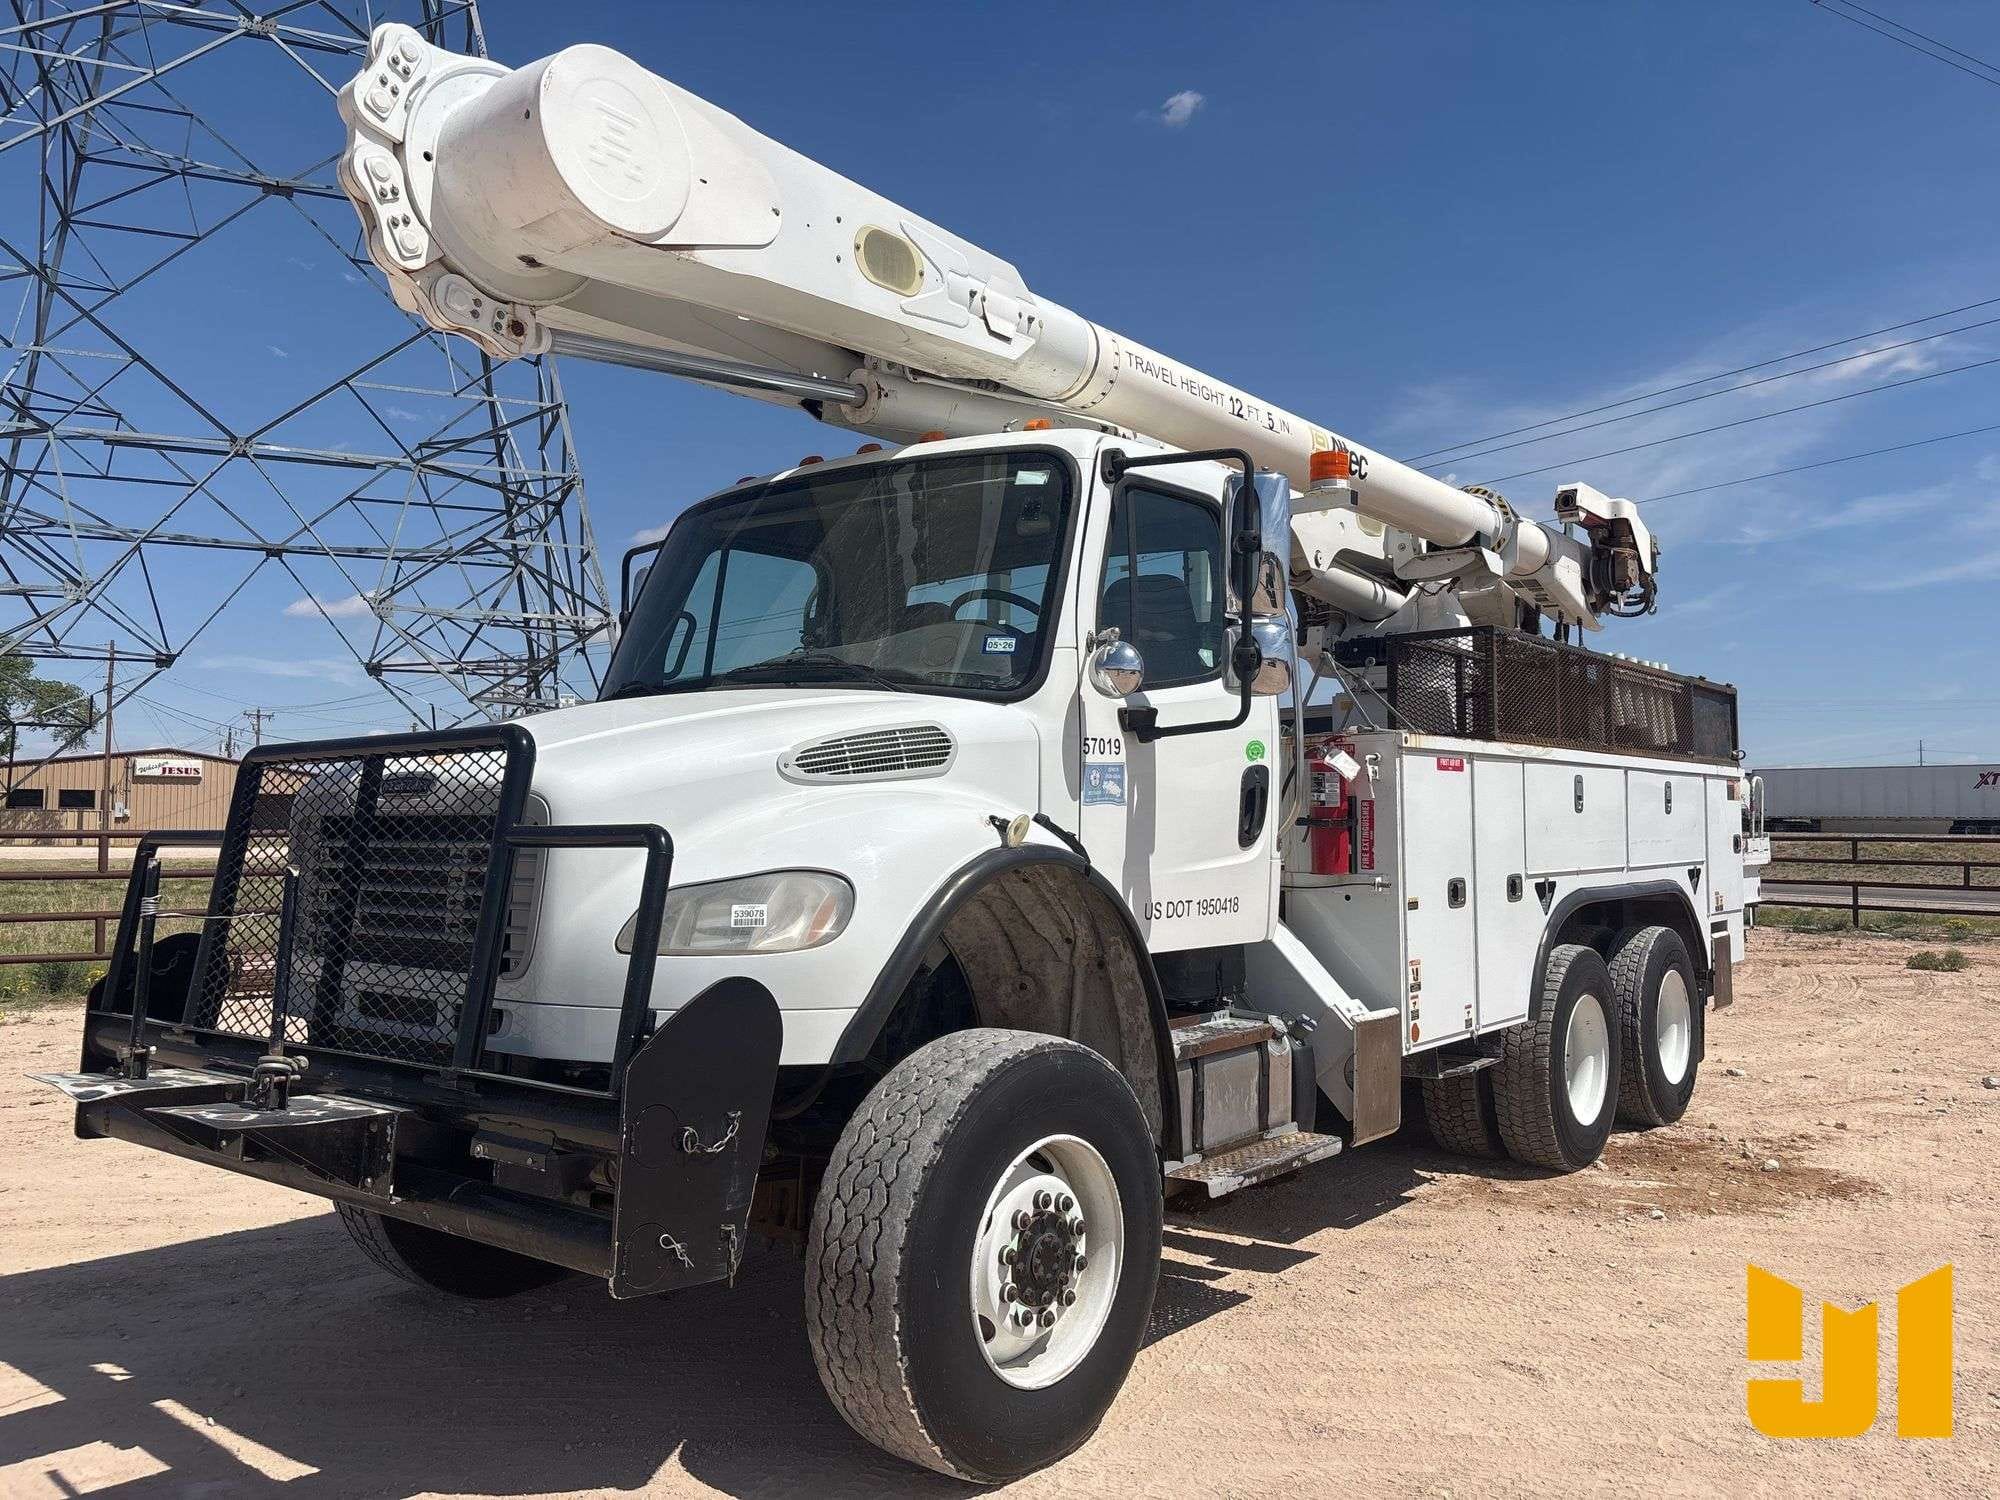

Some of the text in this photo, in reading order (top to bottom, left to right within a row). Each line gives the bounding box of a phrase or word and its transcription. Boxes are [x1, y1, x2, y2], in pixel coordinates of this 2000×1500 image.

[1125, 351, 1177, 387] TRAVEL
[1180, 376, 1225, 407] HEIGHT
[1229, 396, 1244, 419] 12
[1266, 412, 1275, 431] 5
[1082, 737, 1121, 756] 57019
[161, 767, 200, 775] JESUS
[1362, 801, 1370, 869] FIRE EXTINGUISHER
[734, 909, 765, 918] 539078
[1144, 896, 1240, 920] US DOT 1950418
